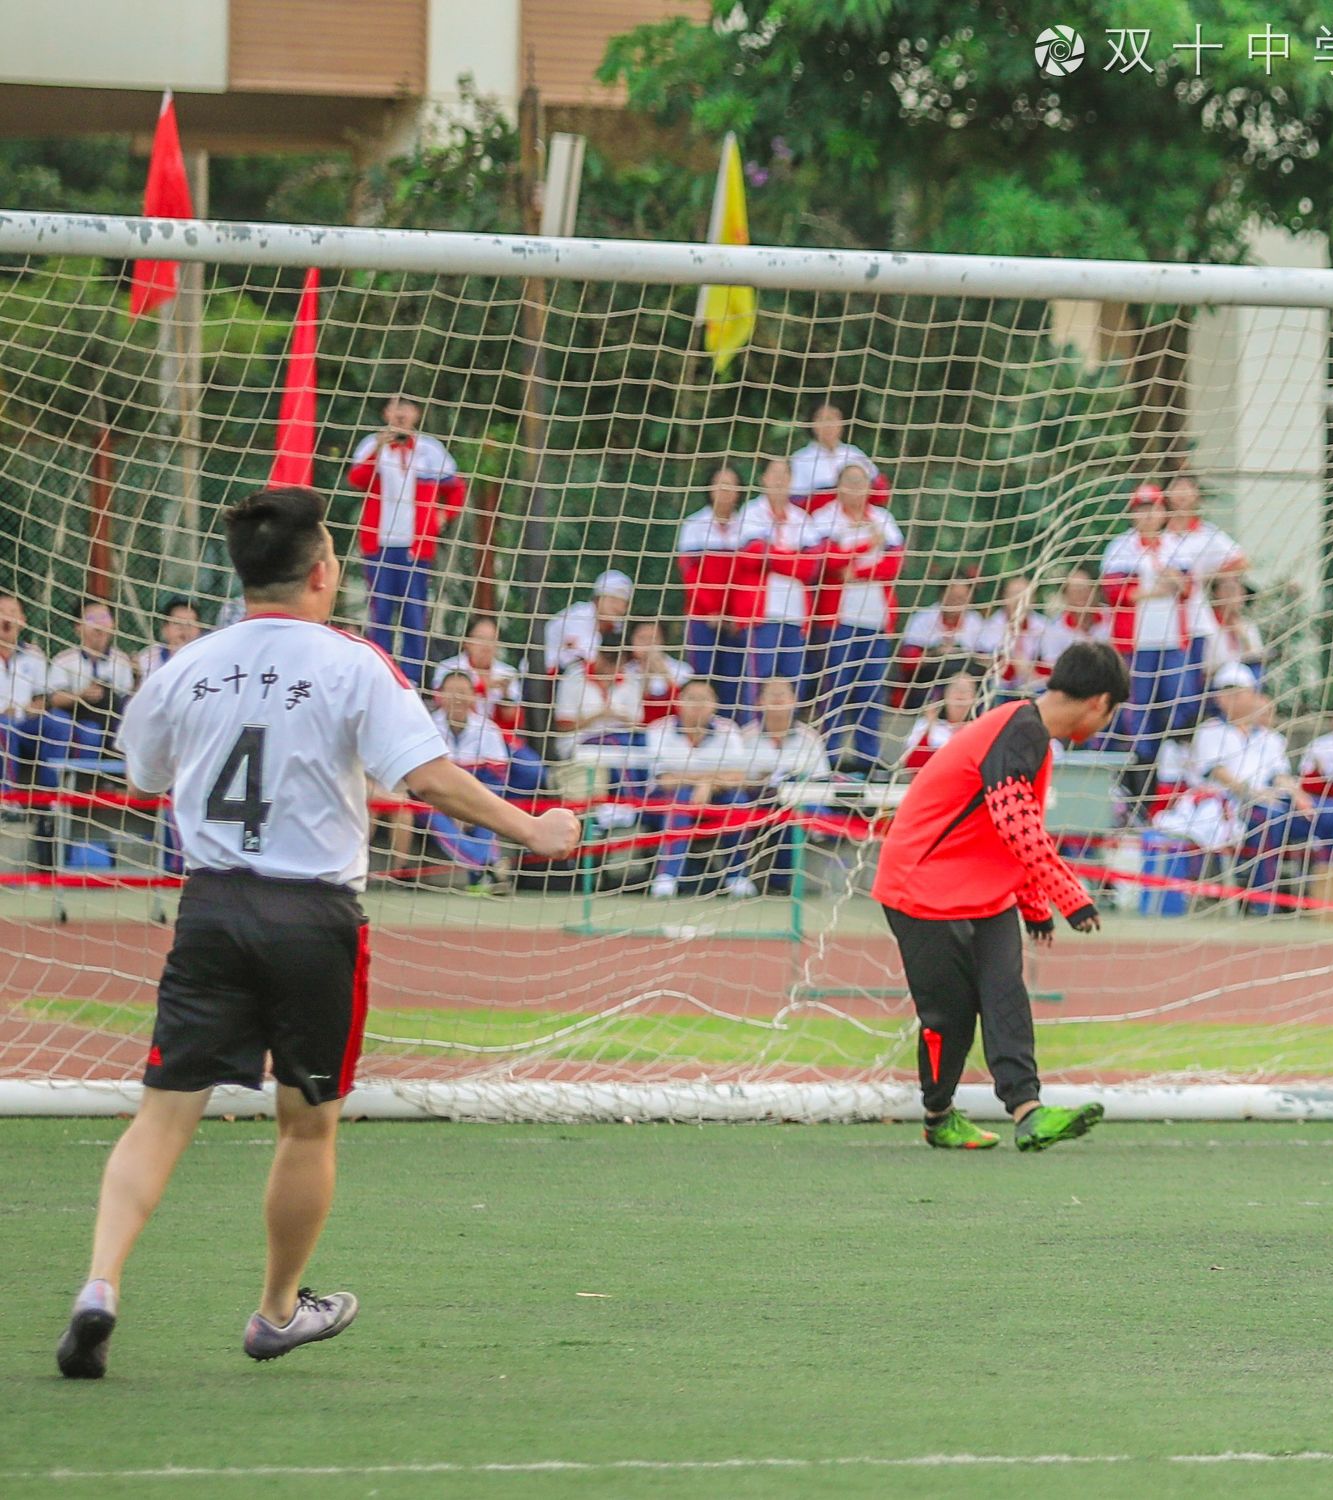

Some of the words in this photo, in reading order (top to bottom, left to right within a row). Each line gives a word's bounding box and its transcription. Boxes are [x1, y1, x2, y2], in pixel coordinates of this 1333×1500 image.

[192, 663, 313, 710] 双十中学
[202, 724, 273, 855] 4
